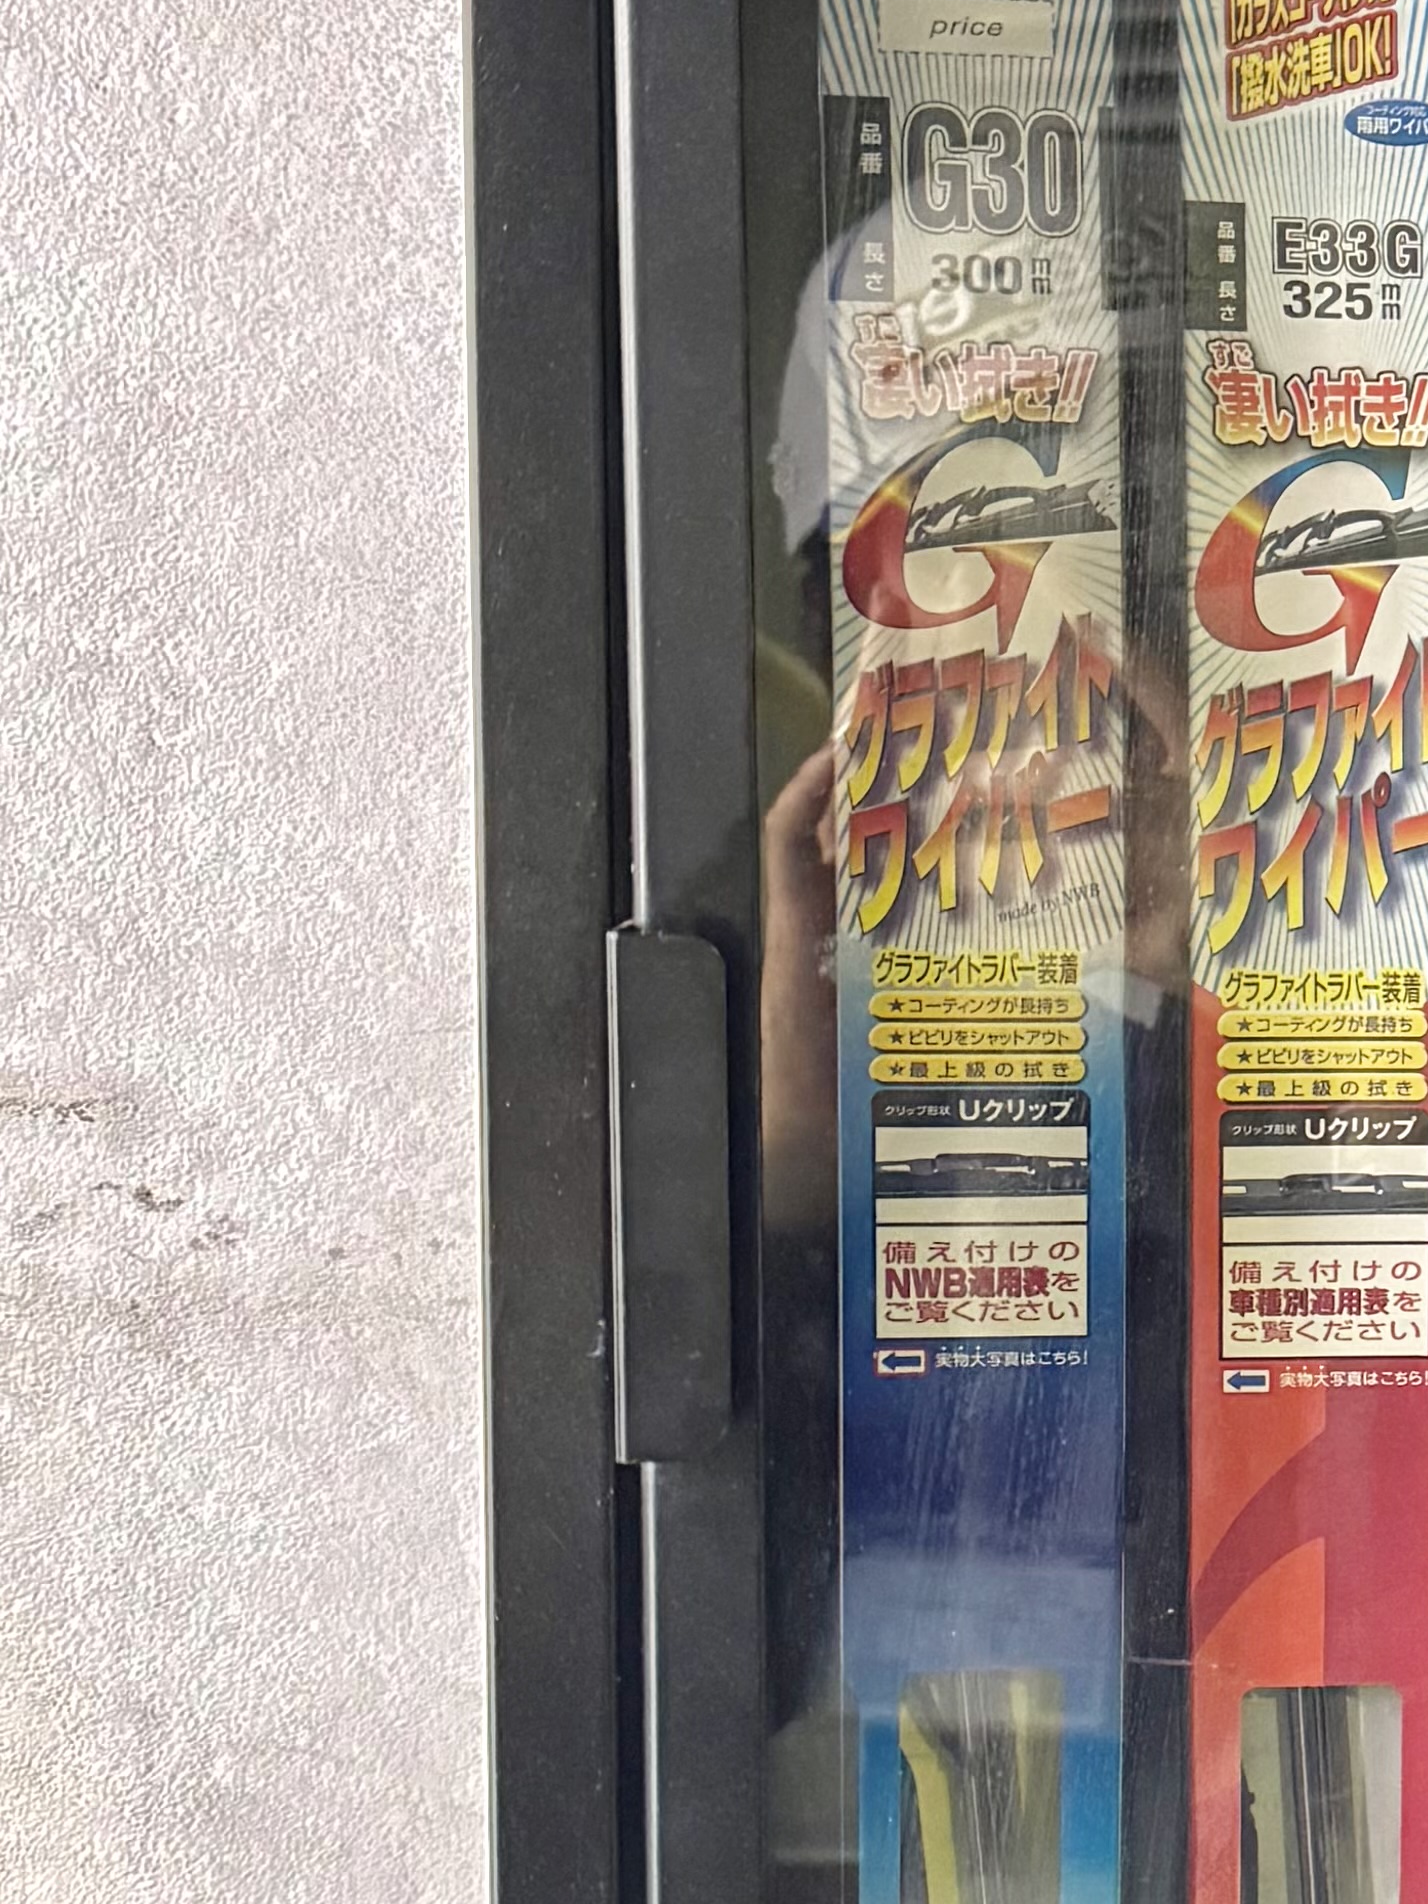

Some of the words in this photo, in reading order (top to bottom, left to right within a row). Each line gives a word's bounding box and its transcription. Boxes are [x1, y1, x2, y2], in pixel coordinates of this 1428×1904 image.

[929, 15, 1003, 38] price
[902, 101, 1084, 240] G30
[1272, 217, 1424, 280] E33G
[845, 611, 1112, 808] グラファイト
[849, 751, 1112, 934] ワイパー
[1225, 971, 1422, 1007] グラファイトラバー装着
[959, 1098, 1074, 1122] Uクリップ
